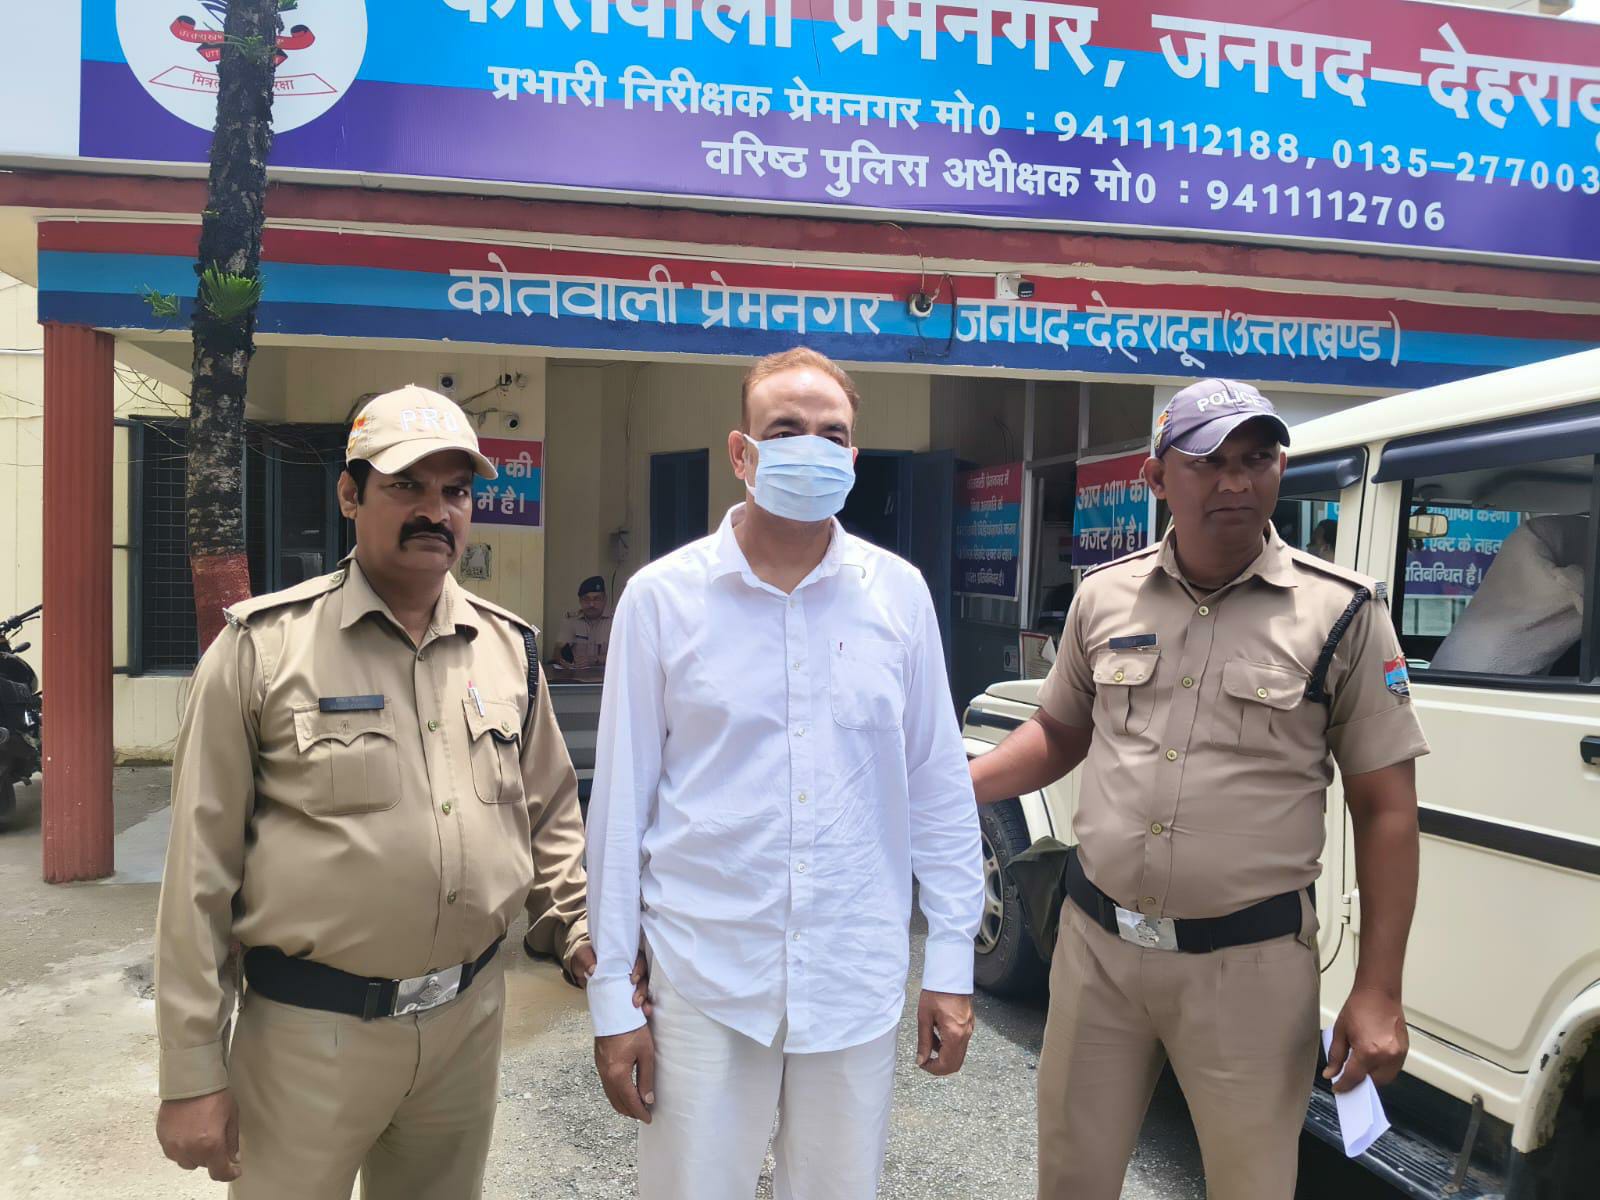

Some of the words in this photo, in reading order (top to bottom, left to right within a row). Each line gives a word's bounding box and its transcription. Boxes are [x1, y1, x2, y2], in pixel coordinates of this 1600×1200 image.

[488, 60, 607, 107] प्रभारी
[619, 65, 773, 118] निरीक्षक
[784, 76, 922, 130] प्रेमनगर
[701, 131, 808, 178] वरिष्ठ
[820, 139, 929, 197] पुलिस
[942, 148, 1081, 197] अधीक्षक
[1206, 180, 1445, 231] 9411112706
[447, 251, 684, 324] कोतवाली
[692, 270, 894, 335] प्रेमनगर
[1196, 390, 1264, 412] POLICE
[505, 451, 533, 478] की
[477, 485, 499, 511] में
[1077, 484, 1101, 510] आप
[1080, 527, 1111, 551] नजर
[1111, 516, 1125, 549] में
[1458, 533, 1473, 551] के
